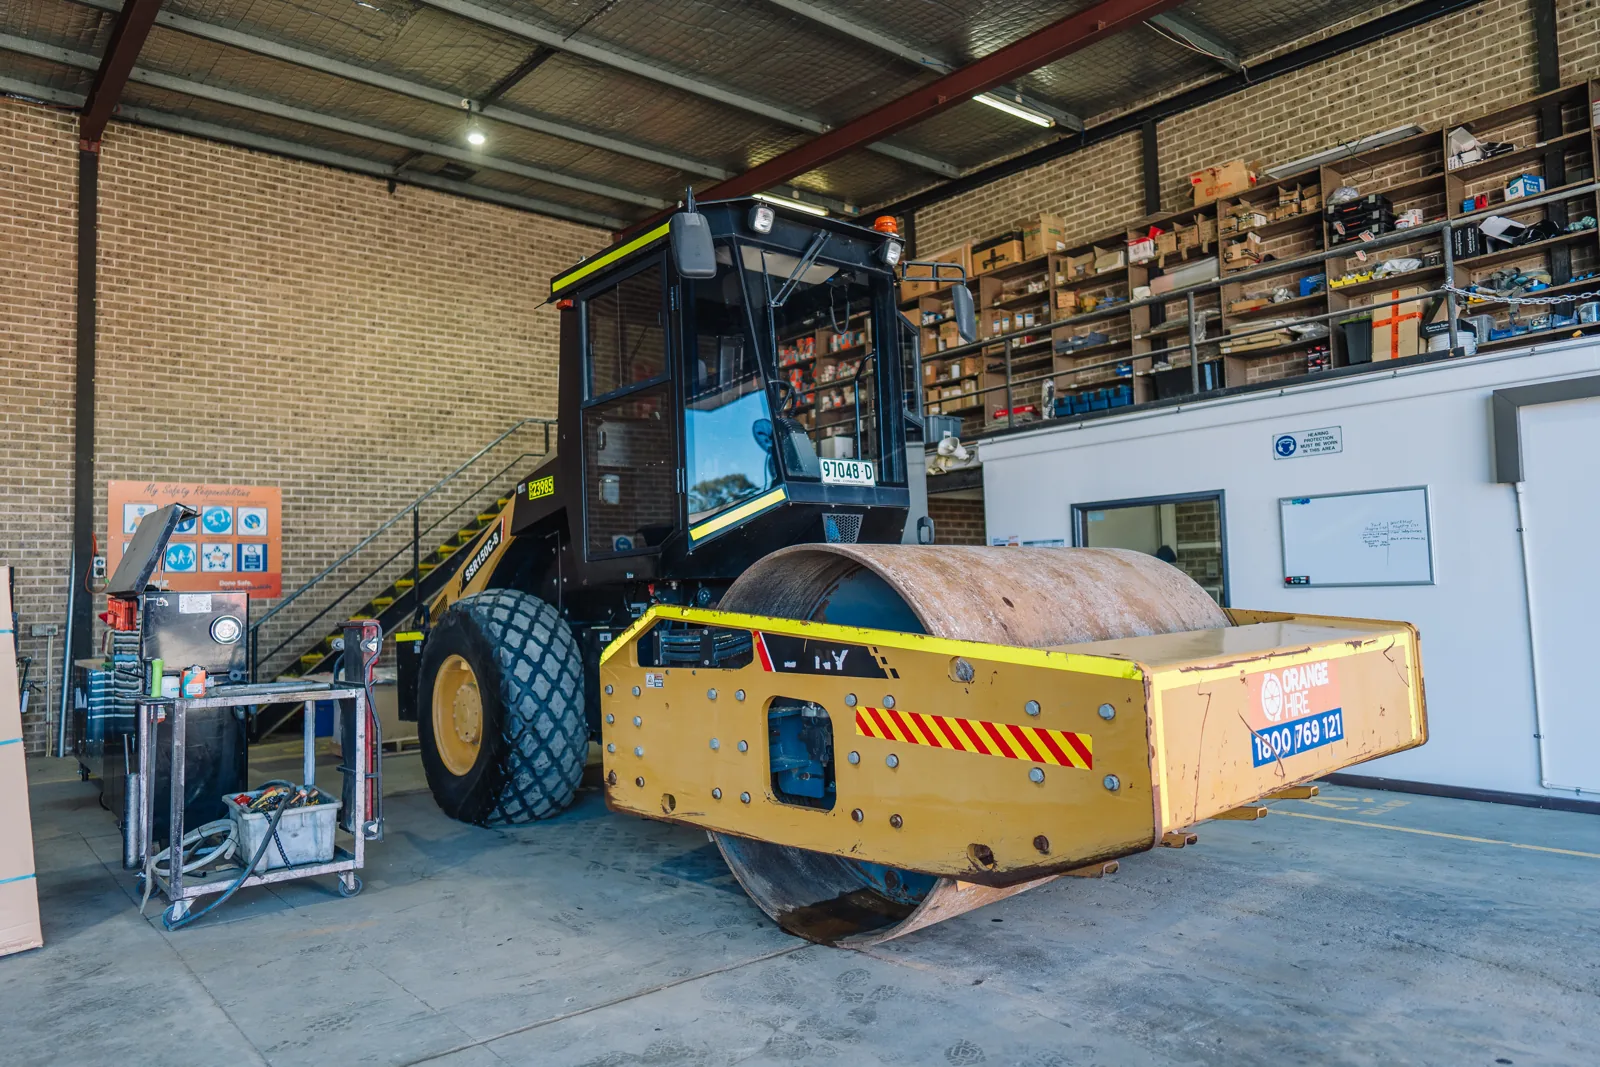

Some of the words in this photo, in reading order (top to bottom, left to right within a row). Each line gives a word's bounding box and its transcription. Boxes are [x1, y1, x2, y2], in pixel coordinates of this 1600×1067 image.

[143, 483, 158, 497] My
[161, 484, 190, 498] Safety
[193, 485, 250, 498] Responsibilities
[532, 478, 553, 496] 23985
[1282, 661, 1329, 693] ORANGE
[1284, 690, 1311, 719] HIRE
[1254, 727, 1292, 761] 1800
[1294, 719, 1320, 749] 769
[1322, 712, 1342, 740] 121
